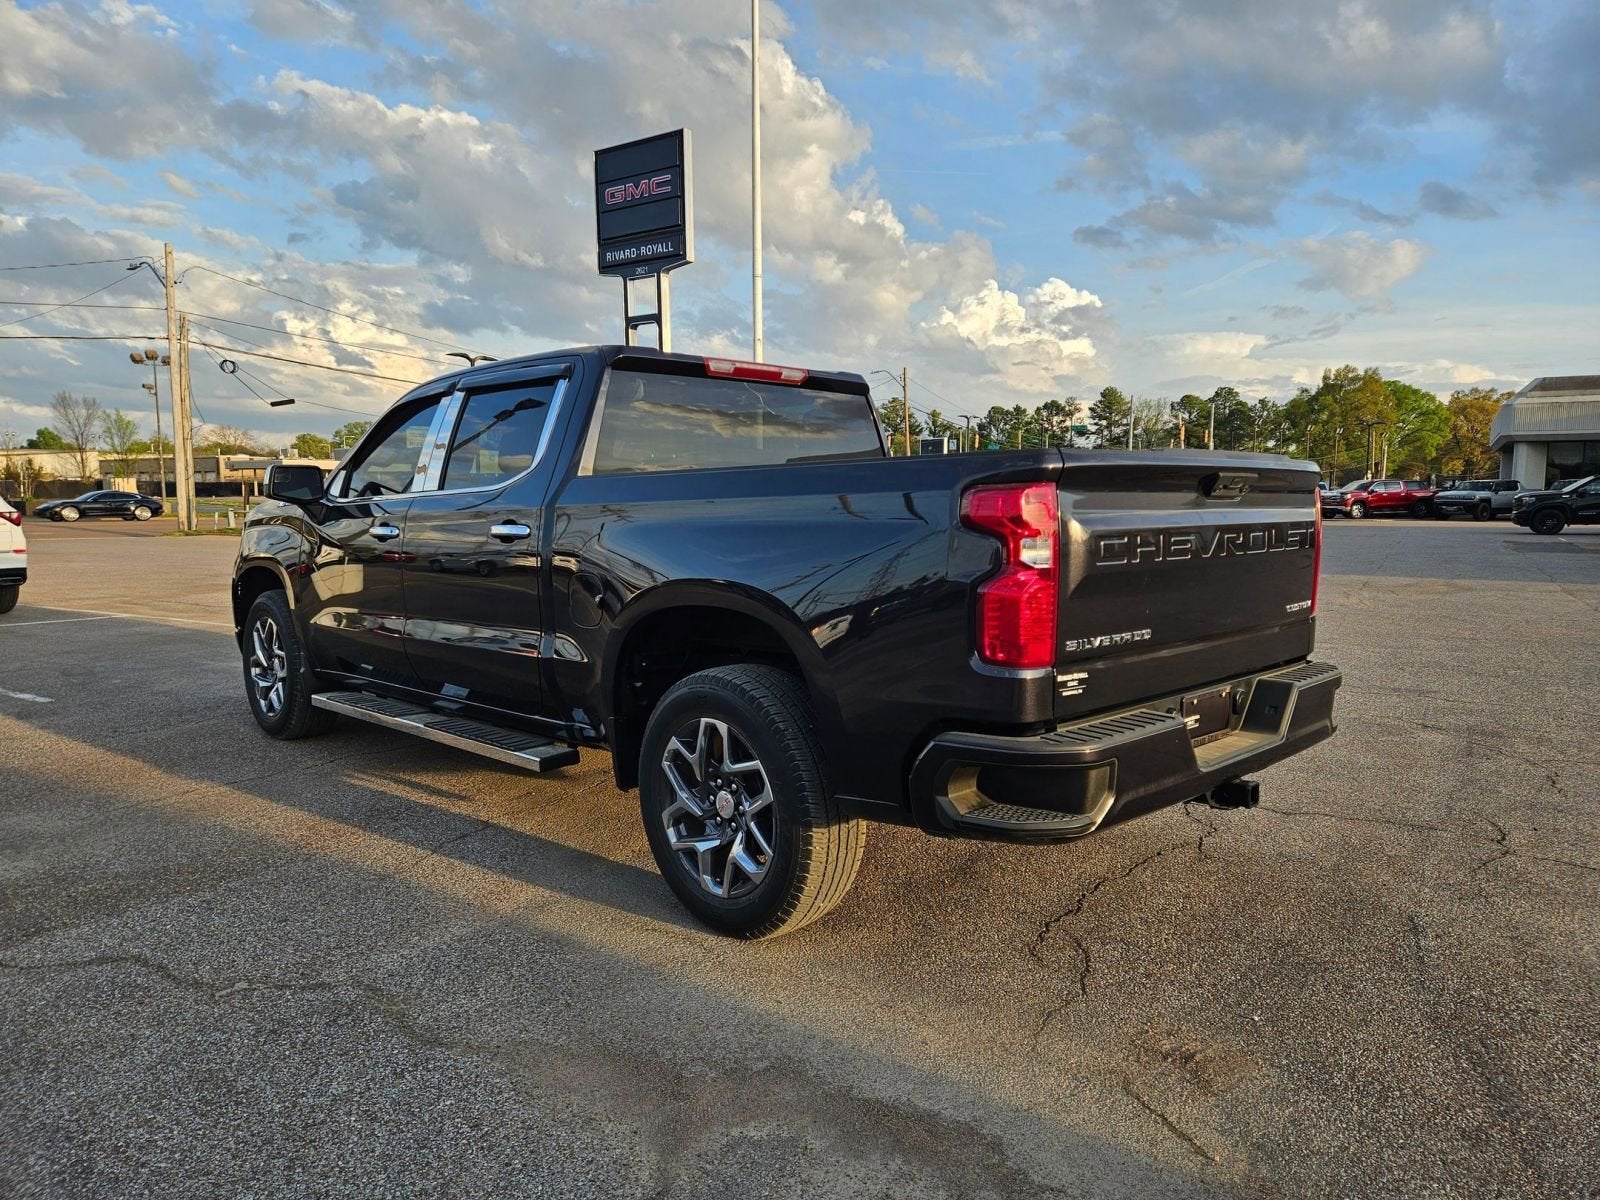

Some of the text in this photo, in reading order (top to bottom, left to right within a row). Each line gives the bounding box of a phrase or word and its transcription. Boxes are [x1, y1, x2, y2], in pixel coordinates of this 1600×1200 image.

[604, 174, 672, 205] GMC
[606, 241, 674, 262] RIVARD-ROYALL
[1095, 527, 1315, 566] CHEVROLET
[1065, 628, 1152, 652] SILVERADO
